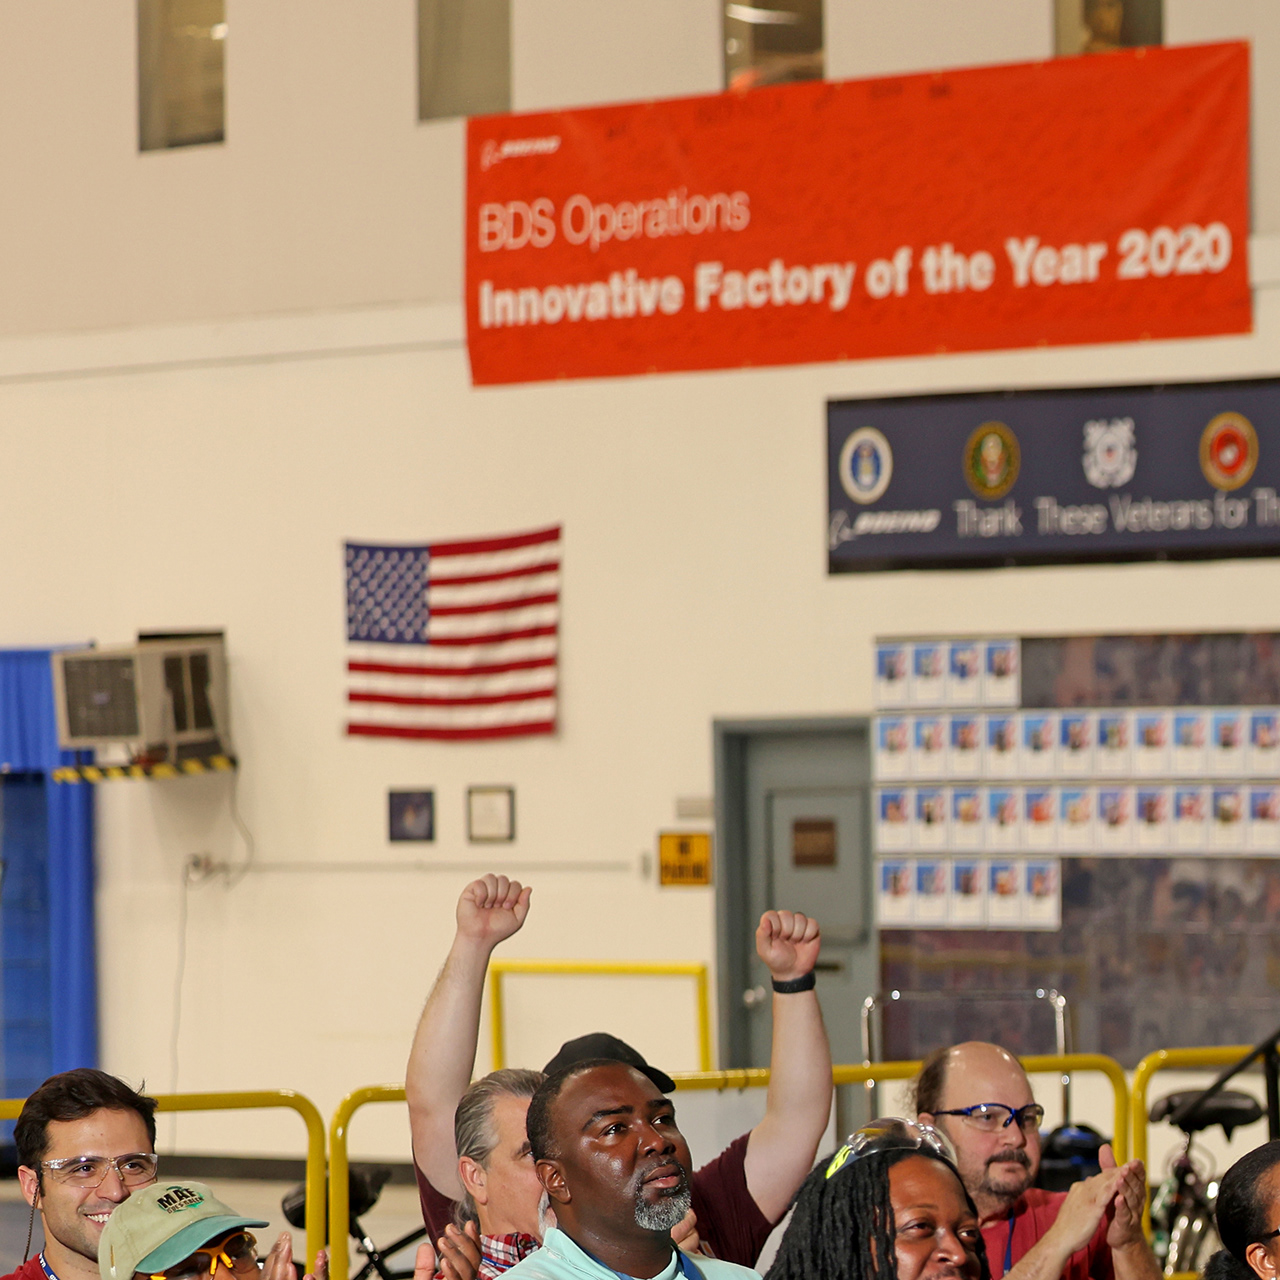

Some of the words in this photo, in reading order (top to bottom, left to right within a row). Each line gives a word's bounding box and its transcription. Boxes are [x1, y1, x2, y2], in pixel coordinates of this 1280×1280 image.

[479, 197, 556, 252] BDS
[561, 185, 750, 252] Operations
[478, 267, 685, 329] Innovative
[694, 257, 856, 312] Factory
[864, 244, 913, 299] of
[920, 241, 996, 295] the
[1003, 235, 1108, 288] Year
[1116, 220, 1232, 281] 2020
[951, 498, 1023, 538] Thank
[1032, 494, 1108, 536] These
[1108, 491, 1213, 534] Veterans
